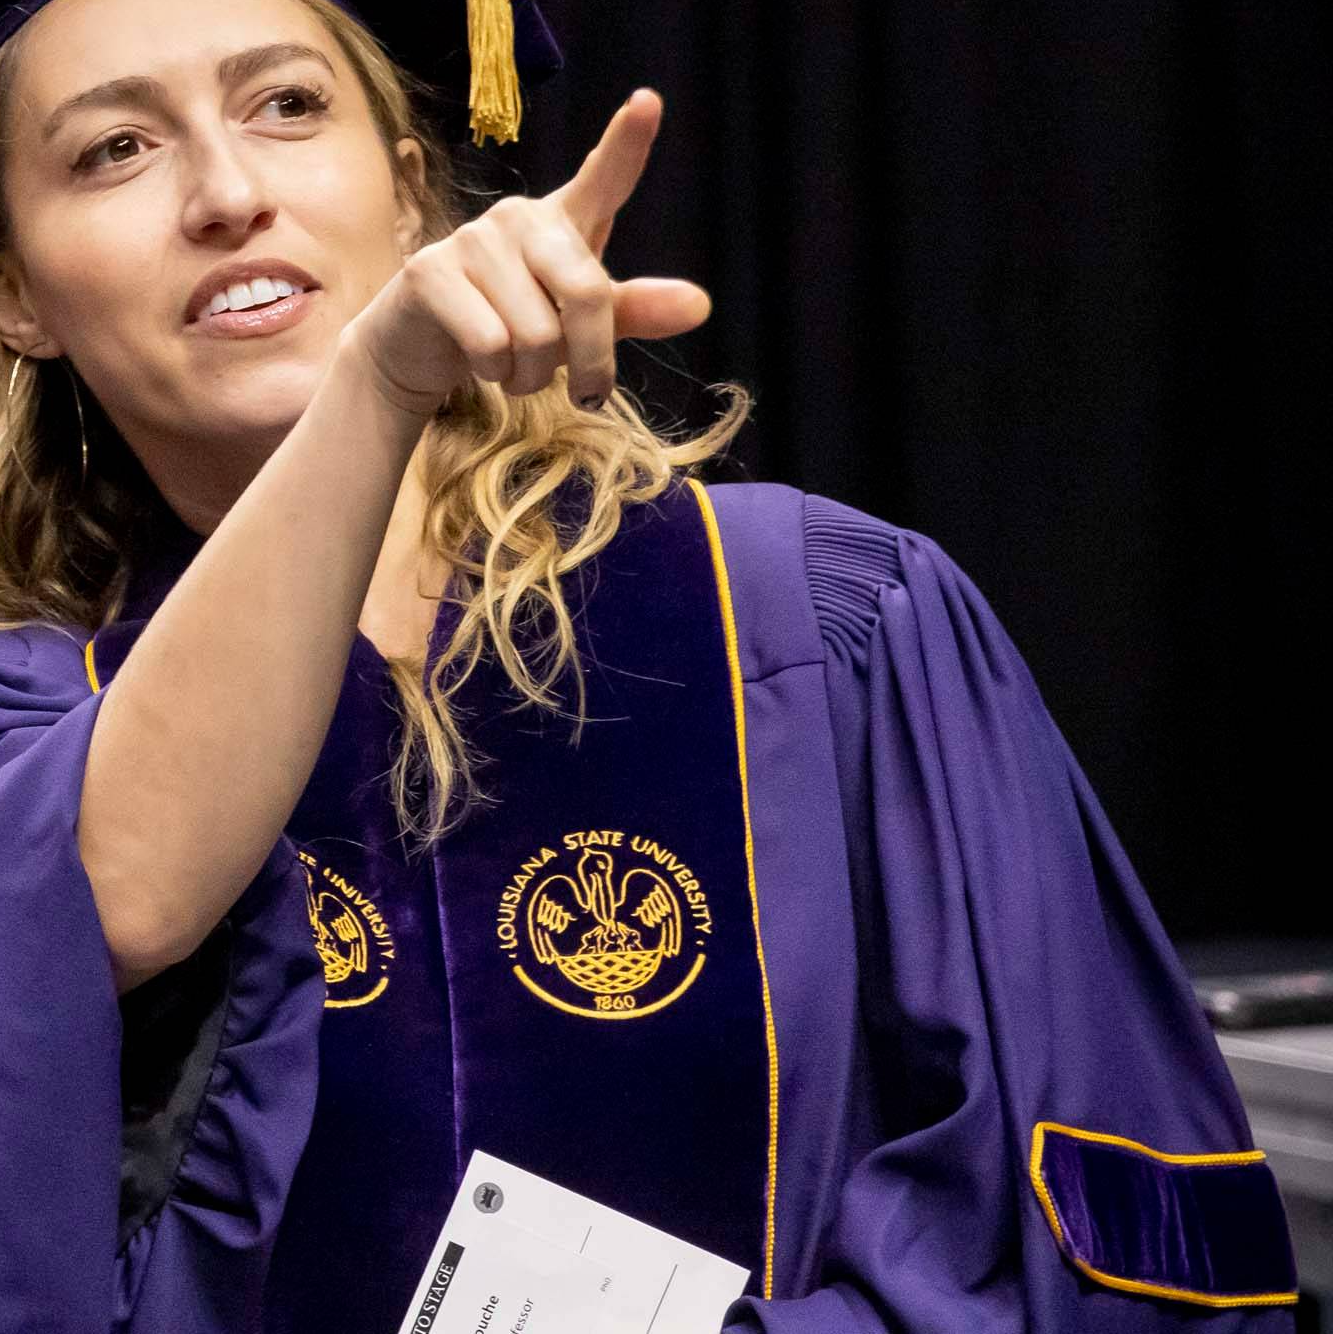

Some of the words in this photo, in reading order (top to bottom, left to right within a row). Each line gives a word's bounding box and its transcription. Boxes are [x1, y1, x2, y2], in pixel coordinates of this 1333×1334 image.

[497, 847, 558, 949] LOUISIANA
[563, 829, 625, 851] STATE
[630, 835, 713, 934] UNIVERSITY
[592, 994, 637, 1011] 1860
[423, 1262, 454, 1314] STAGE
